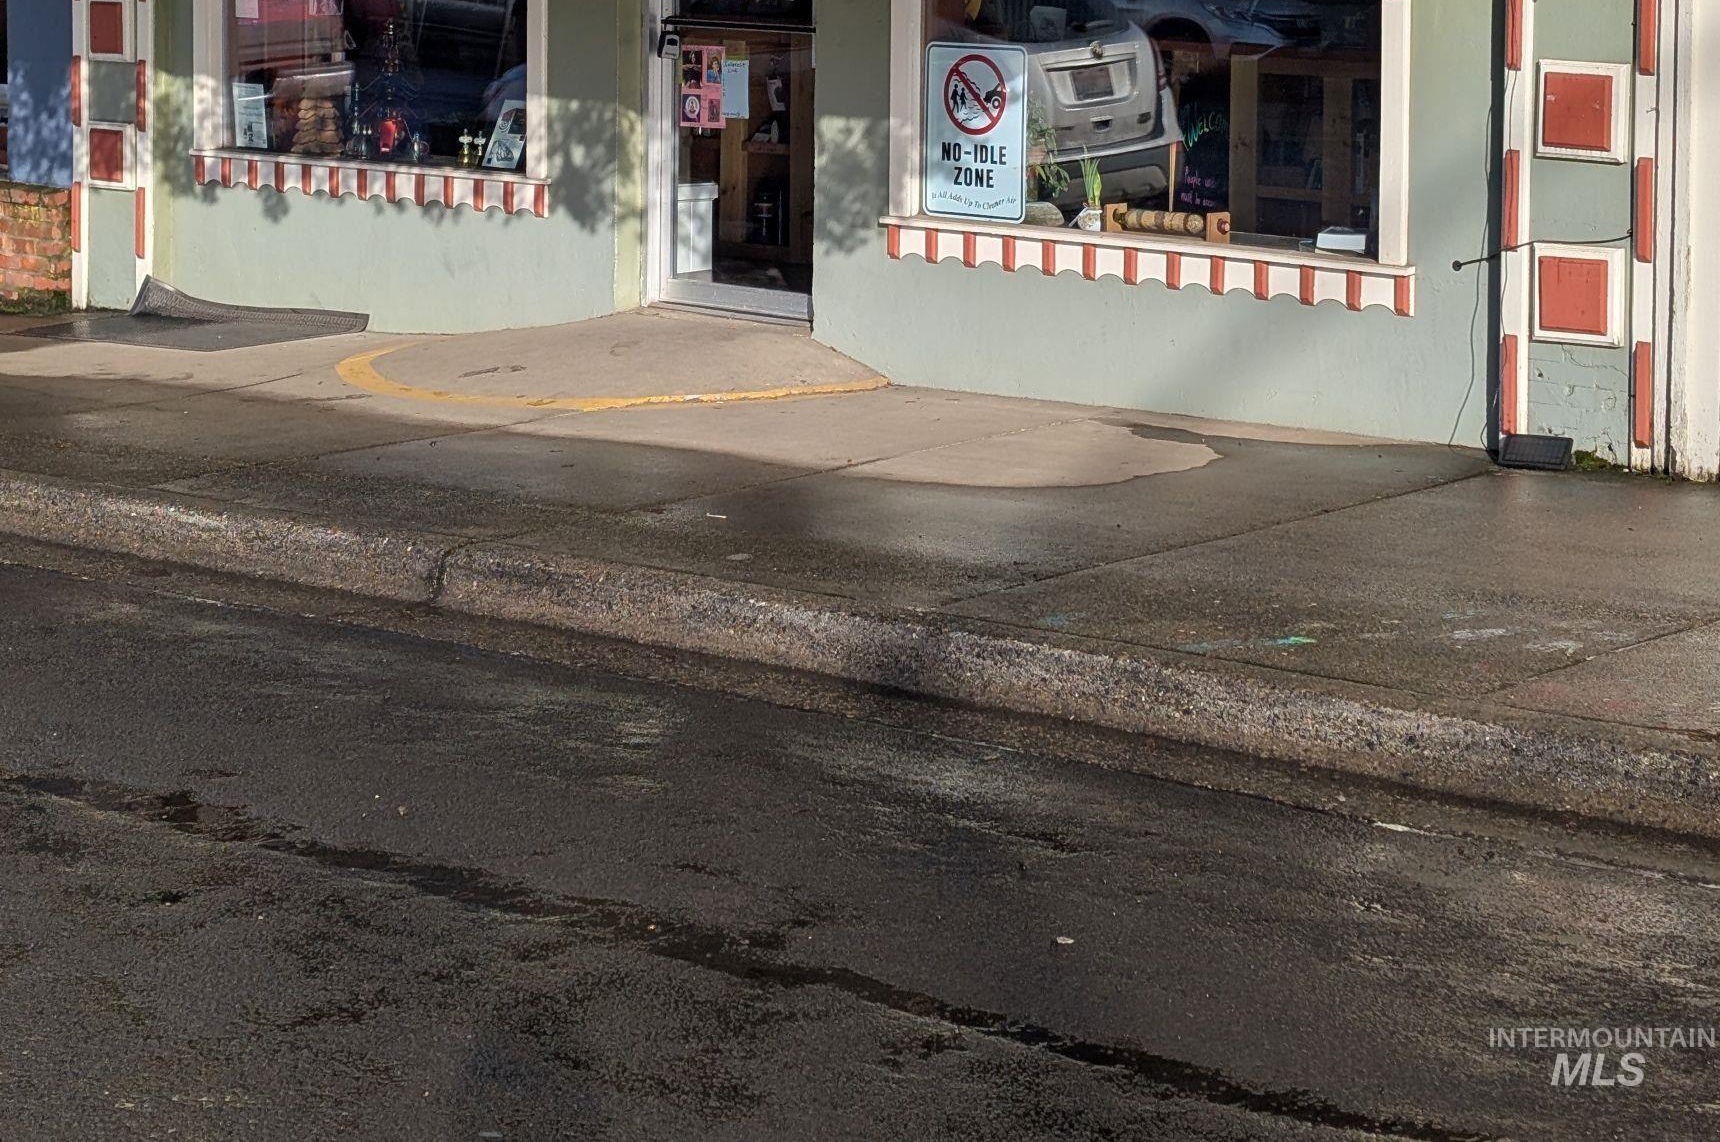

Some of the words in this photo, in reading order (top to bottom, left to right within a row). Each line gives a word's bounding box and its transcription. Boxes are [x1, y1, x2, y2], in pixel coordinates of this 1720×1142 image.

[941, 141, 1007, 165] NO-IDLE
[953, 166, 994, 188] ZONE
[948, 192, 962, 203] Adds
[964, 197, 973, 207] Up
[974, 200, 981, 208] To
[982, 199, 1004, 210] Cleaner
[1006, 196, 1016, 204] Air
